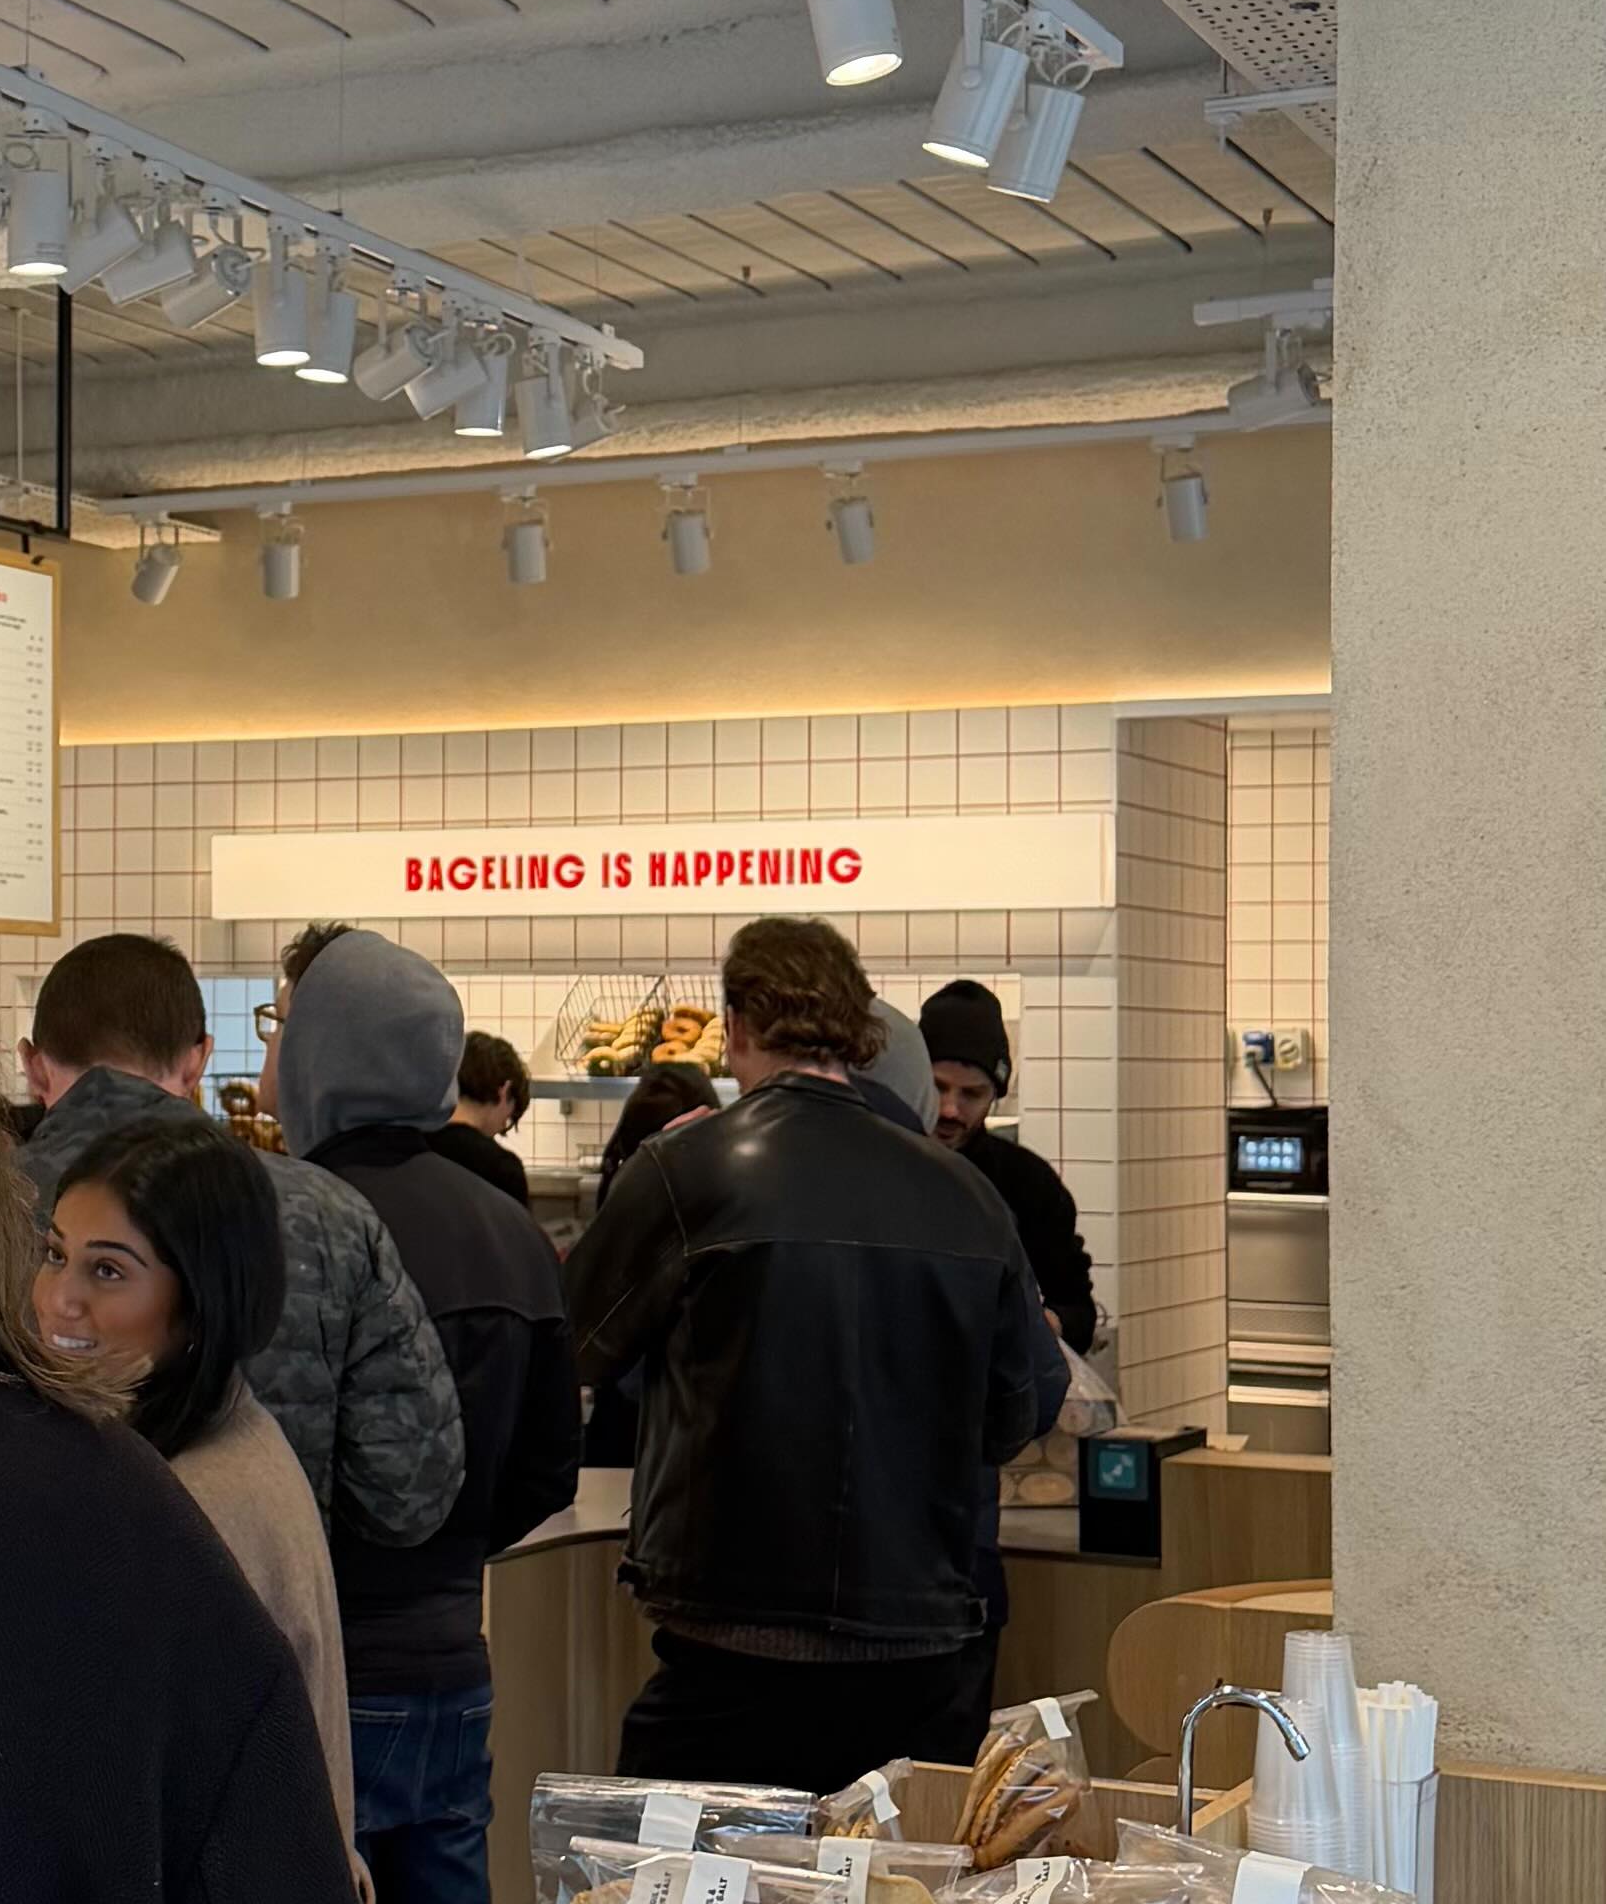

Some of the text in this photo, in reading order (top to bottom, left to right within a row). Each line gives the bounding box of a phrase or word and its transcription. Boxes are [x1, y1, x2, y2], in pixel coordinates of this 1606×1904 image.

[406, 847, 864, 893] BAGELING IS HAPPENING
[717, 1877, 728, 1902] SALT
